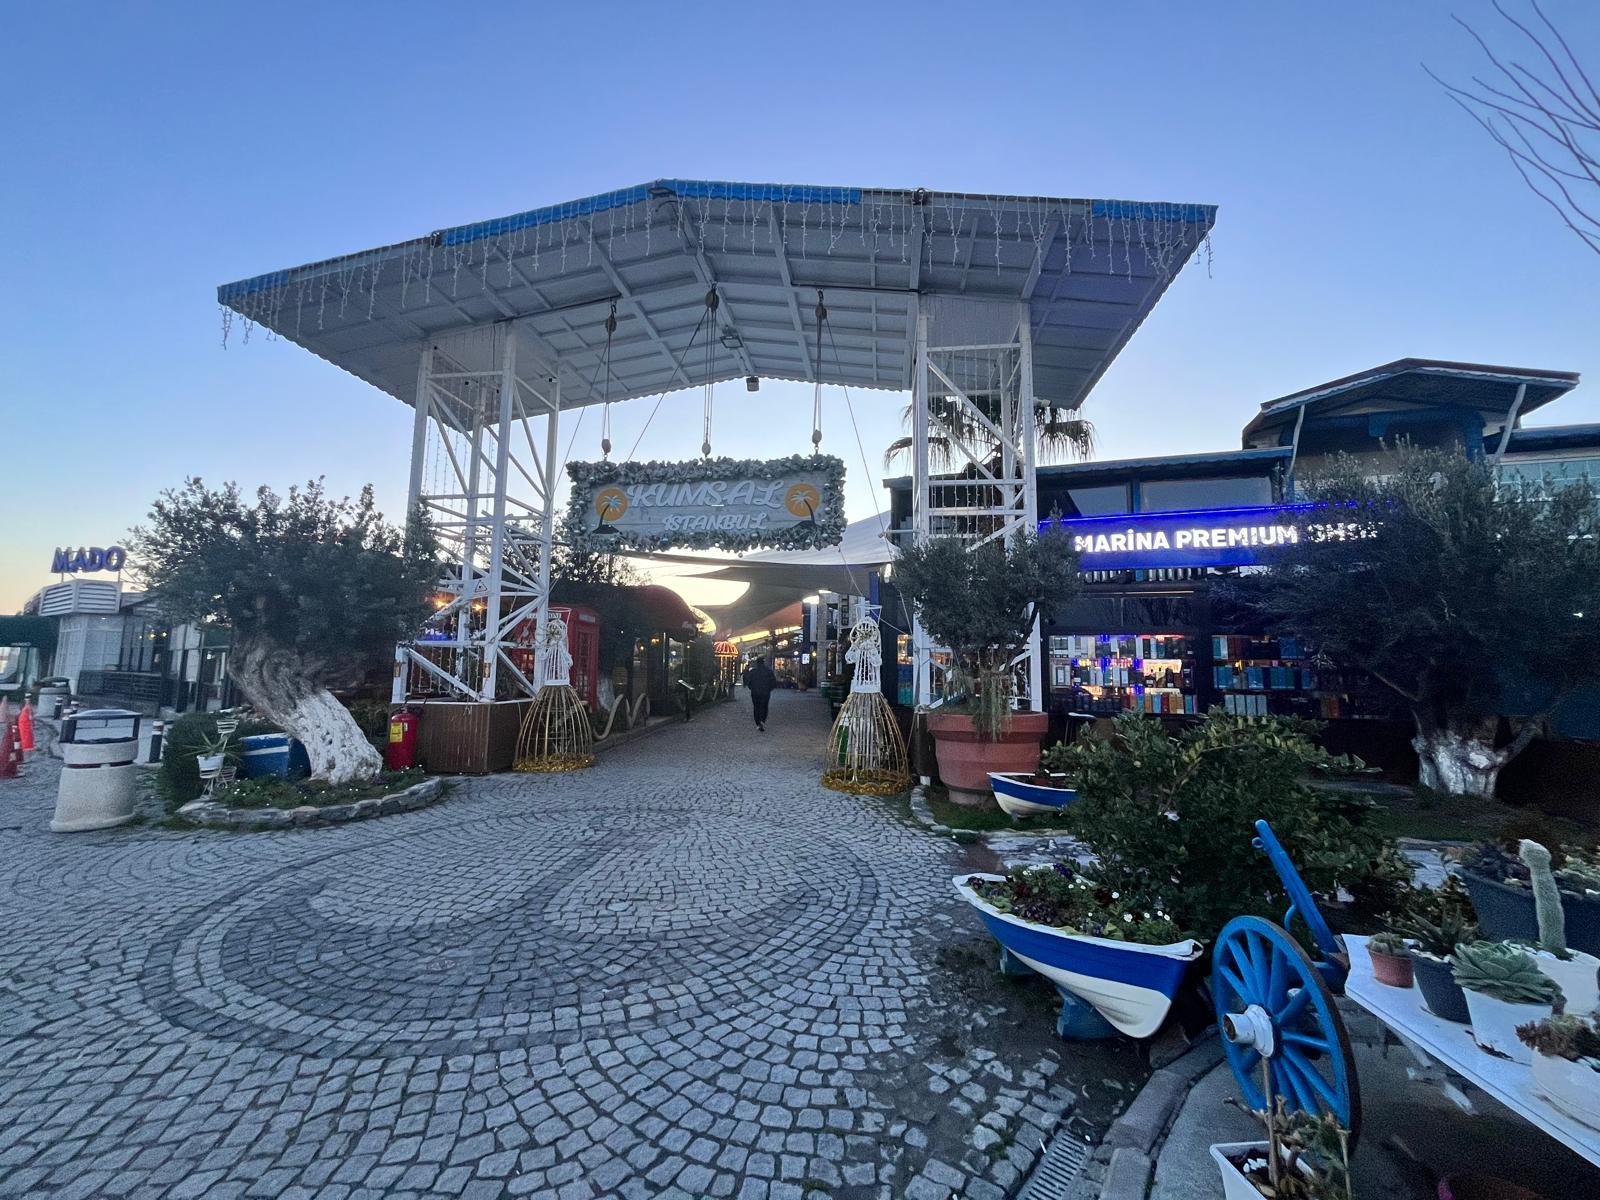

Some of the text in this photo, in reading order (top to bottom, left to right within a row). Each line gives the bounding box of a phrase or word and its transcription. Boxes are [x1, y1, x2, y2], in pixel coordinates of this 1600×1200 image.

[626, 480, 785, 509] KUMSAL
[1074, 528, 1170, 553] MARİNA
[1175, 525, 1298, 549] PREMIUM
[51, 546, 126, 573] MADO
